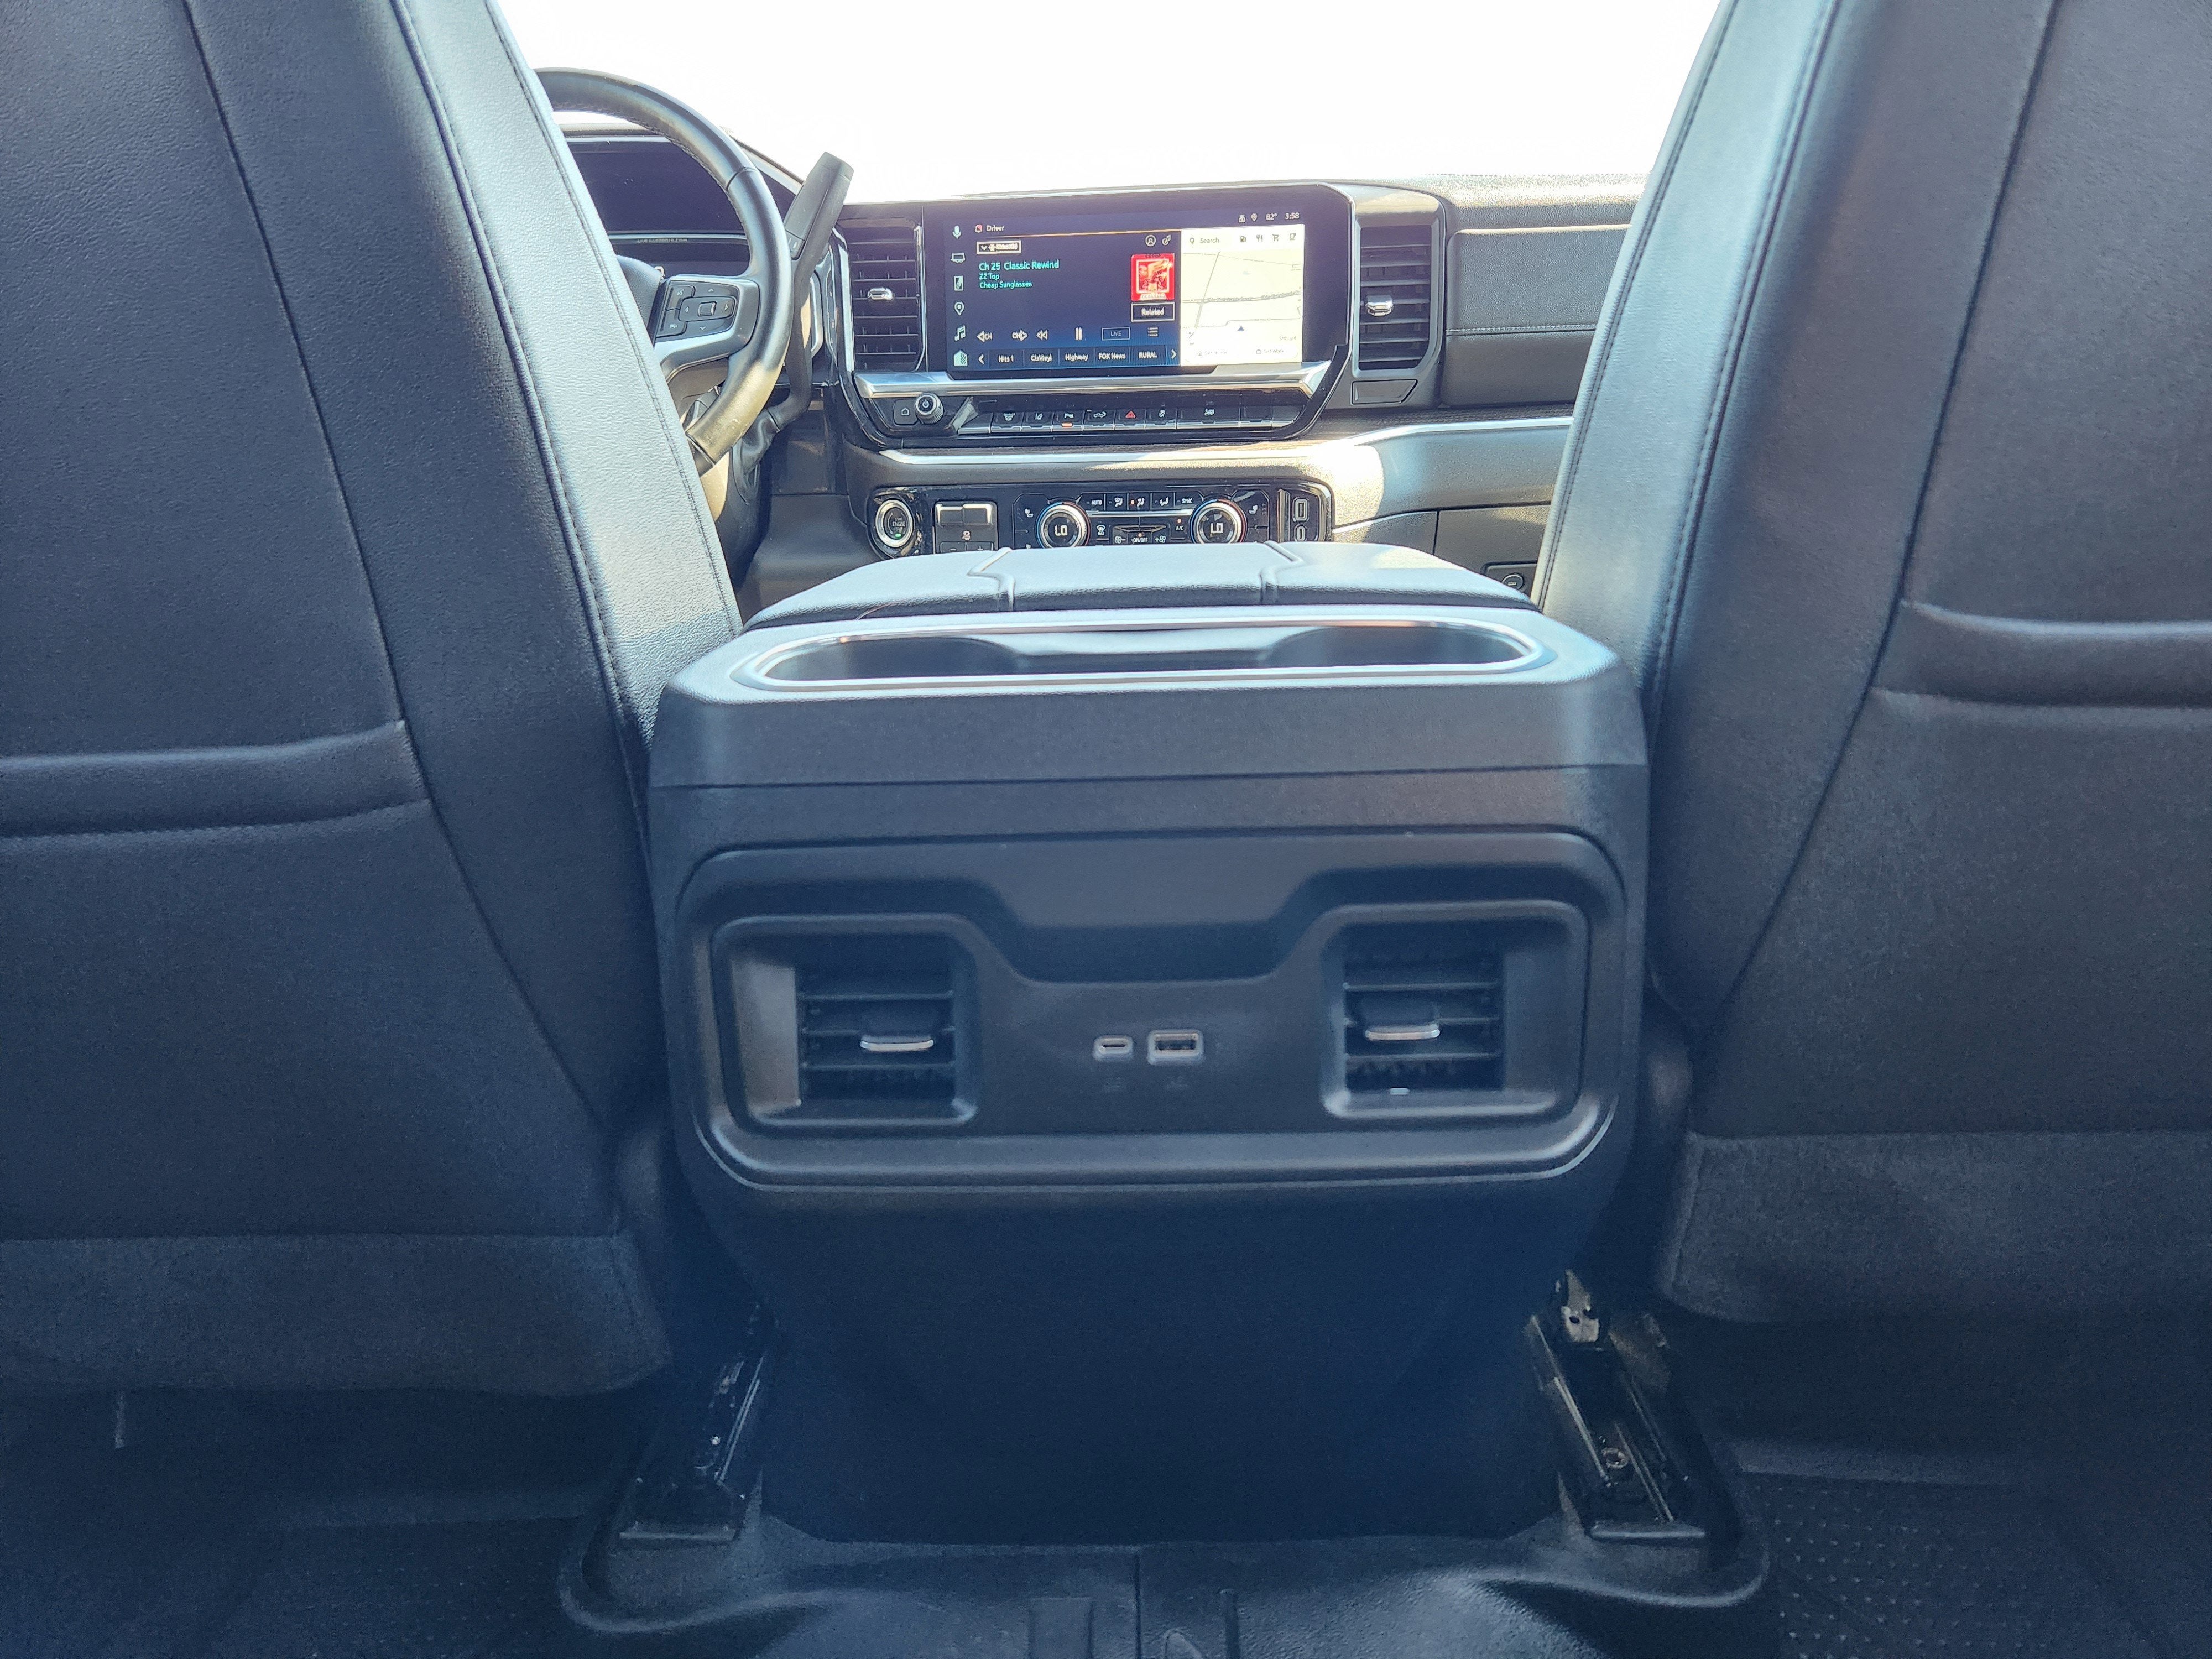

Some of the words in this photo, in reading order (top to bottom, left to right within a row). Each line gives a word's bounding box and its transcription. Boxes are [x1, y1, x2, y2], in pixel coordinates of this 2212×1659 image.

[1266, 212, 1277, 221] 82°
[978, 262, 990, 270] Ch
[990, 262, 1001, 270] 25
[1004, 260, 1030, 270] Classic
[1031, 259, 1060, 269] Rewind
[999, 280, 1032, 289] Sunglasses
[1141, 307, 1165, 316] Related
[1065, 352, 1089, 362] Highway
[1111, 351, 1126, 359] News
[1139, 351, 1157, 359] RURAL
[1055, 525, 1068, 536] LO
[1210, 523, 1223, 534] LO
